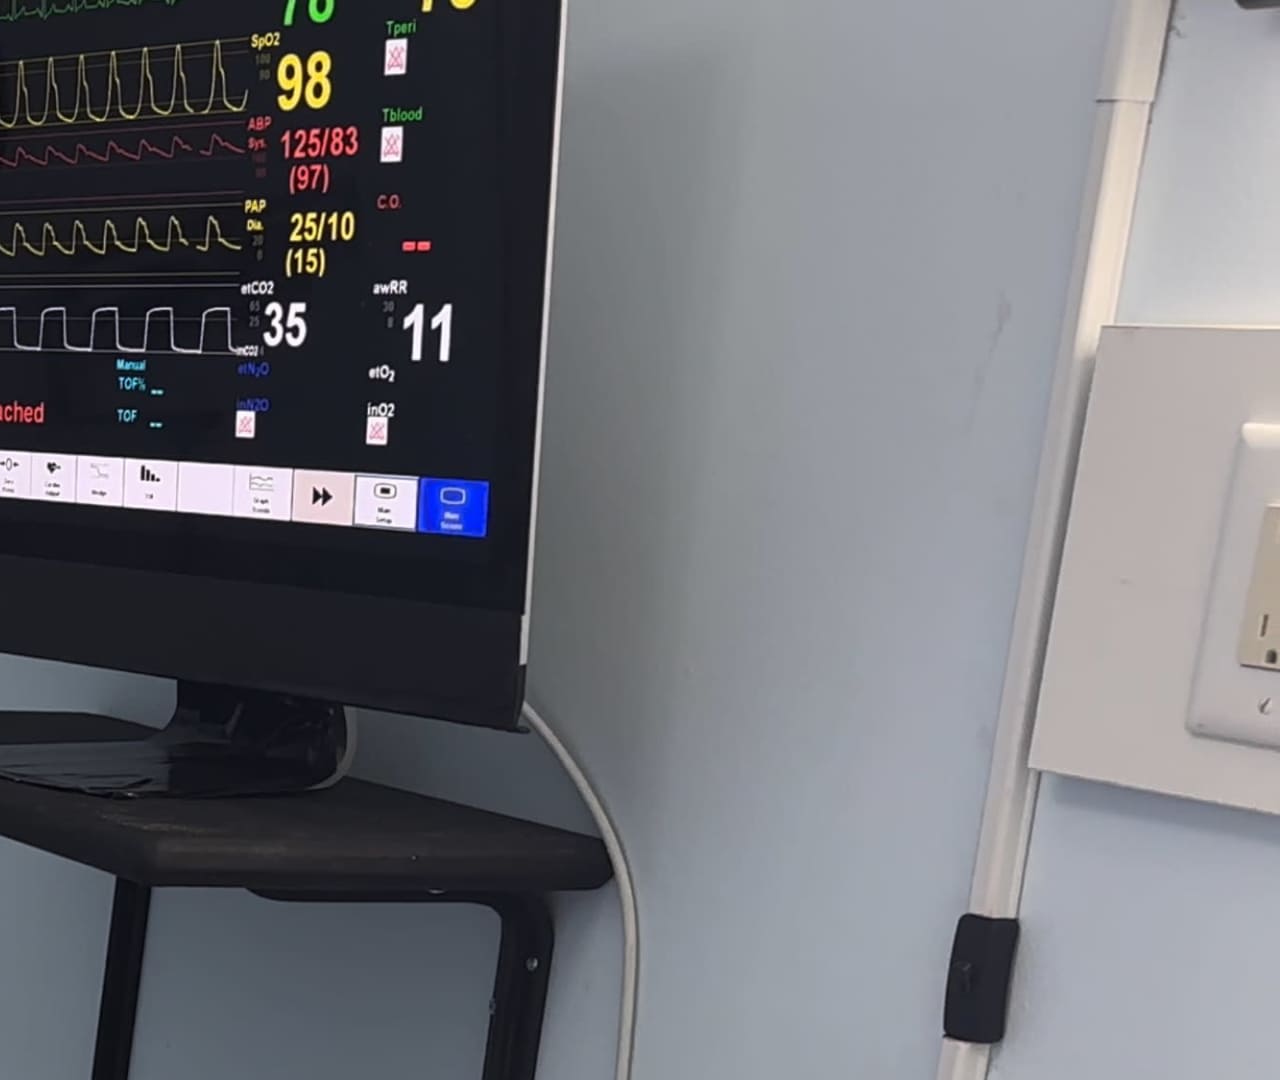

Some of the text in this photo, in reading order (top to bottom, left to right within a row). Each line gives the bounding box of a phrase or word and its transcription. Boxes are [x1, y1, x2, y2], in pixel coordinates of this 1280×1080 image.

[385, 19, 417, 36] Tperi
[251, 32, 281, 51] SpO2
[276, 50, 332, 111] 98
[382, 106, 424, 123] Tblood
[247, 116, 272, 131] ABP
[279, 126, 359, 160] 125/83
[288, 163, 330, 195] (97)
[244, 199, 267, 214] PAP
[376, 194, 402, 210] C.O.
[289, 210, 355, 243] 25/10
[285, 248, 327, 278] (15)
[241, 280, 275, 296] etCO2
[373, 279, 408, 295] awRR
[262, 301, 308, 348] 35
[402, 303, 453, 362] 11
[116, 359, 147, 371] Manual
[118, 376, 146, 391] TOF%
[117, 409, 138, 423] TOF
[367, 403, 395, 417] inO2
